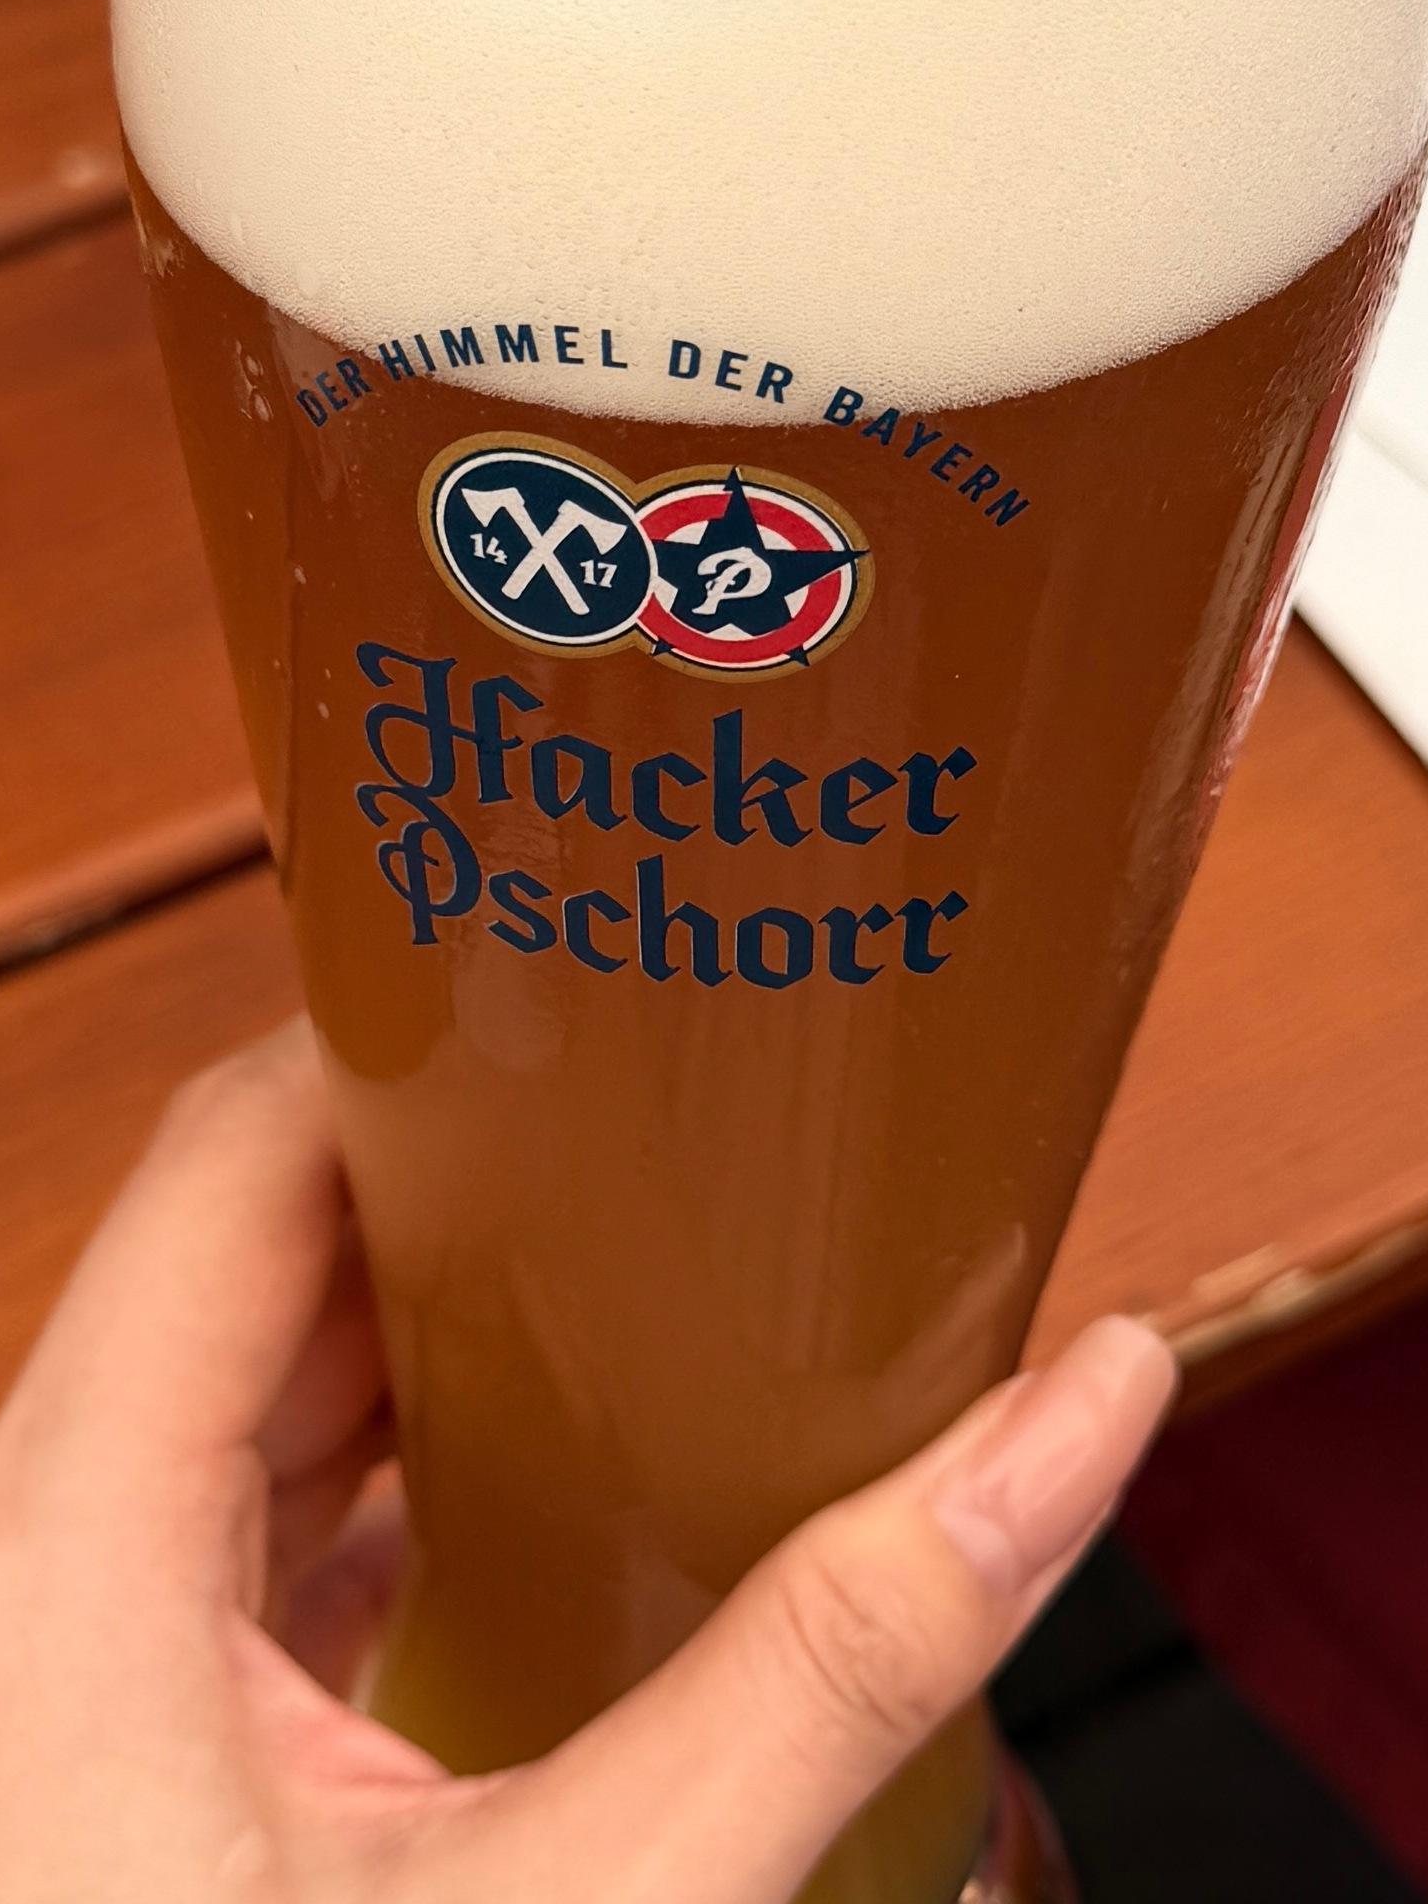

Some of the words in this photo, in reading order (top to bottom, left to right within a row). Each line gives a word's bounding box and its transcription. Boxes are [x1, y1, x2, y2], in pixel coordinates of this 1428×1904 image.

[296, 357, 372, 427] DER
[378, 324, 628, 381] HIMMEL
[668, 339, 793, 403] DER
[823, 386, 1030, 527] BAYERN
[470, 533, 508, 565] 14
[580, 559, 618, 588] 17
[356, 642, 978, 847] Hacker
[356, 783, 969, 990] Pschorr
